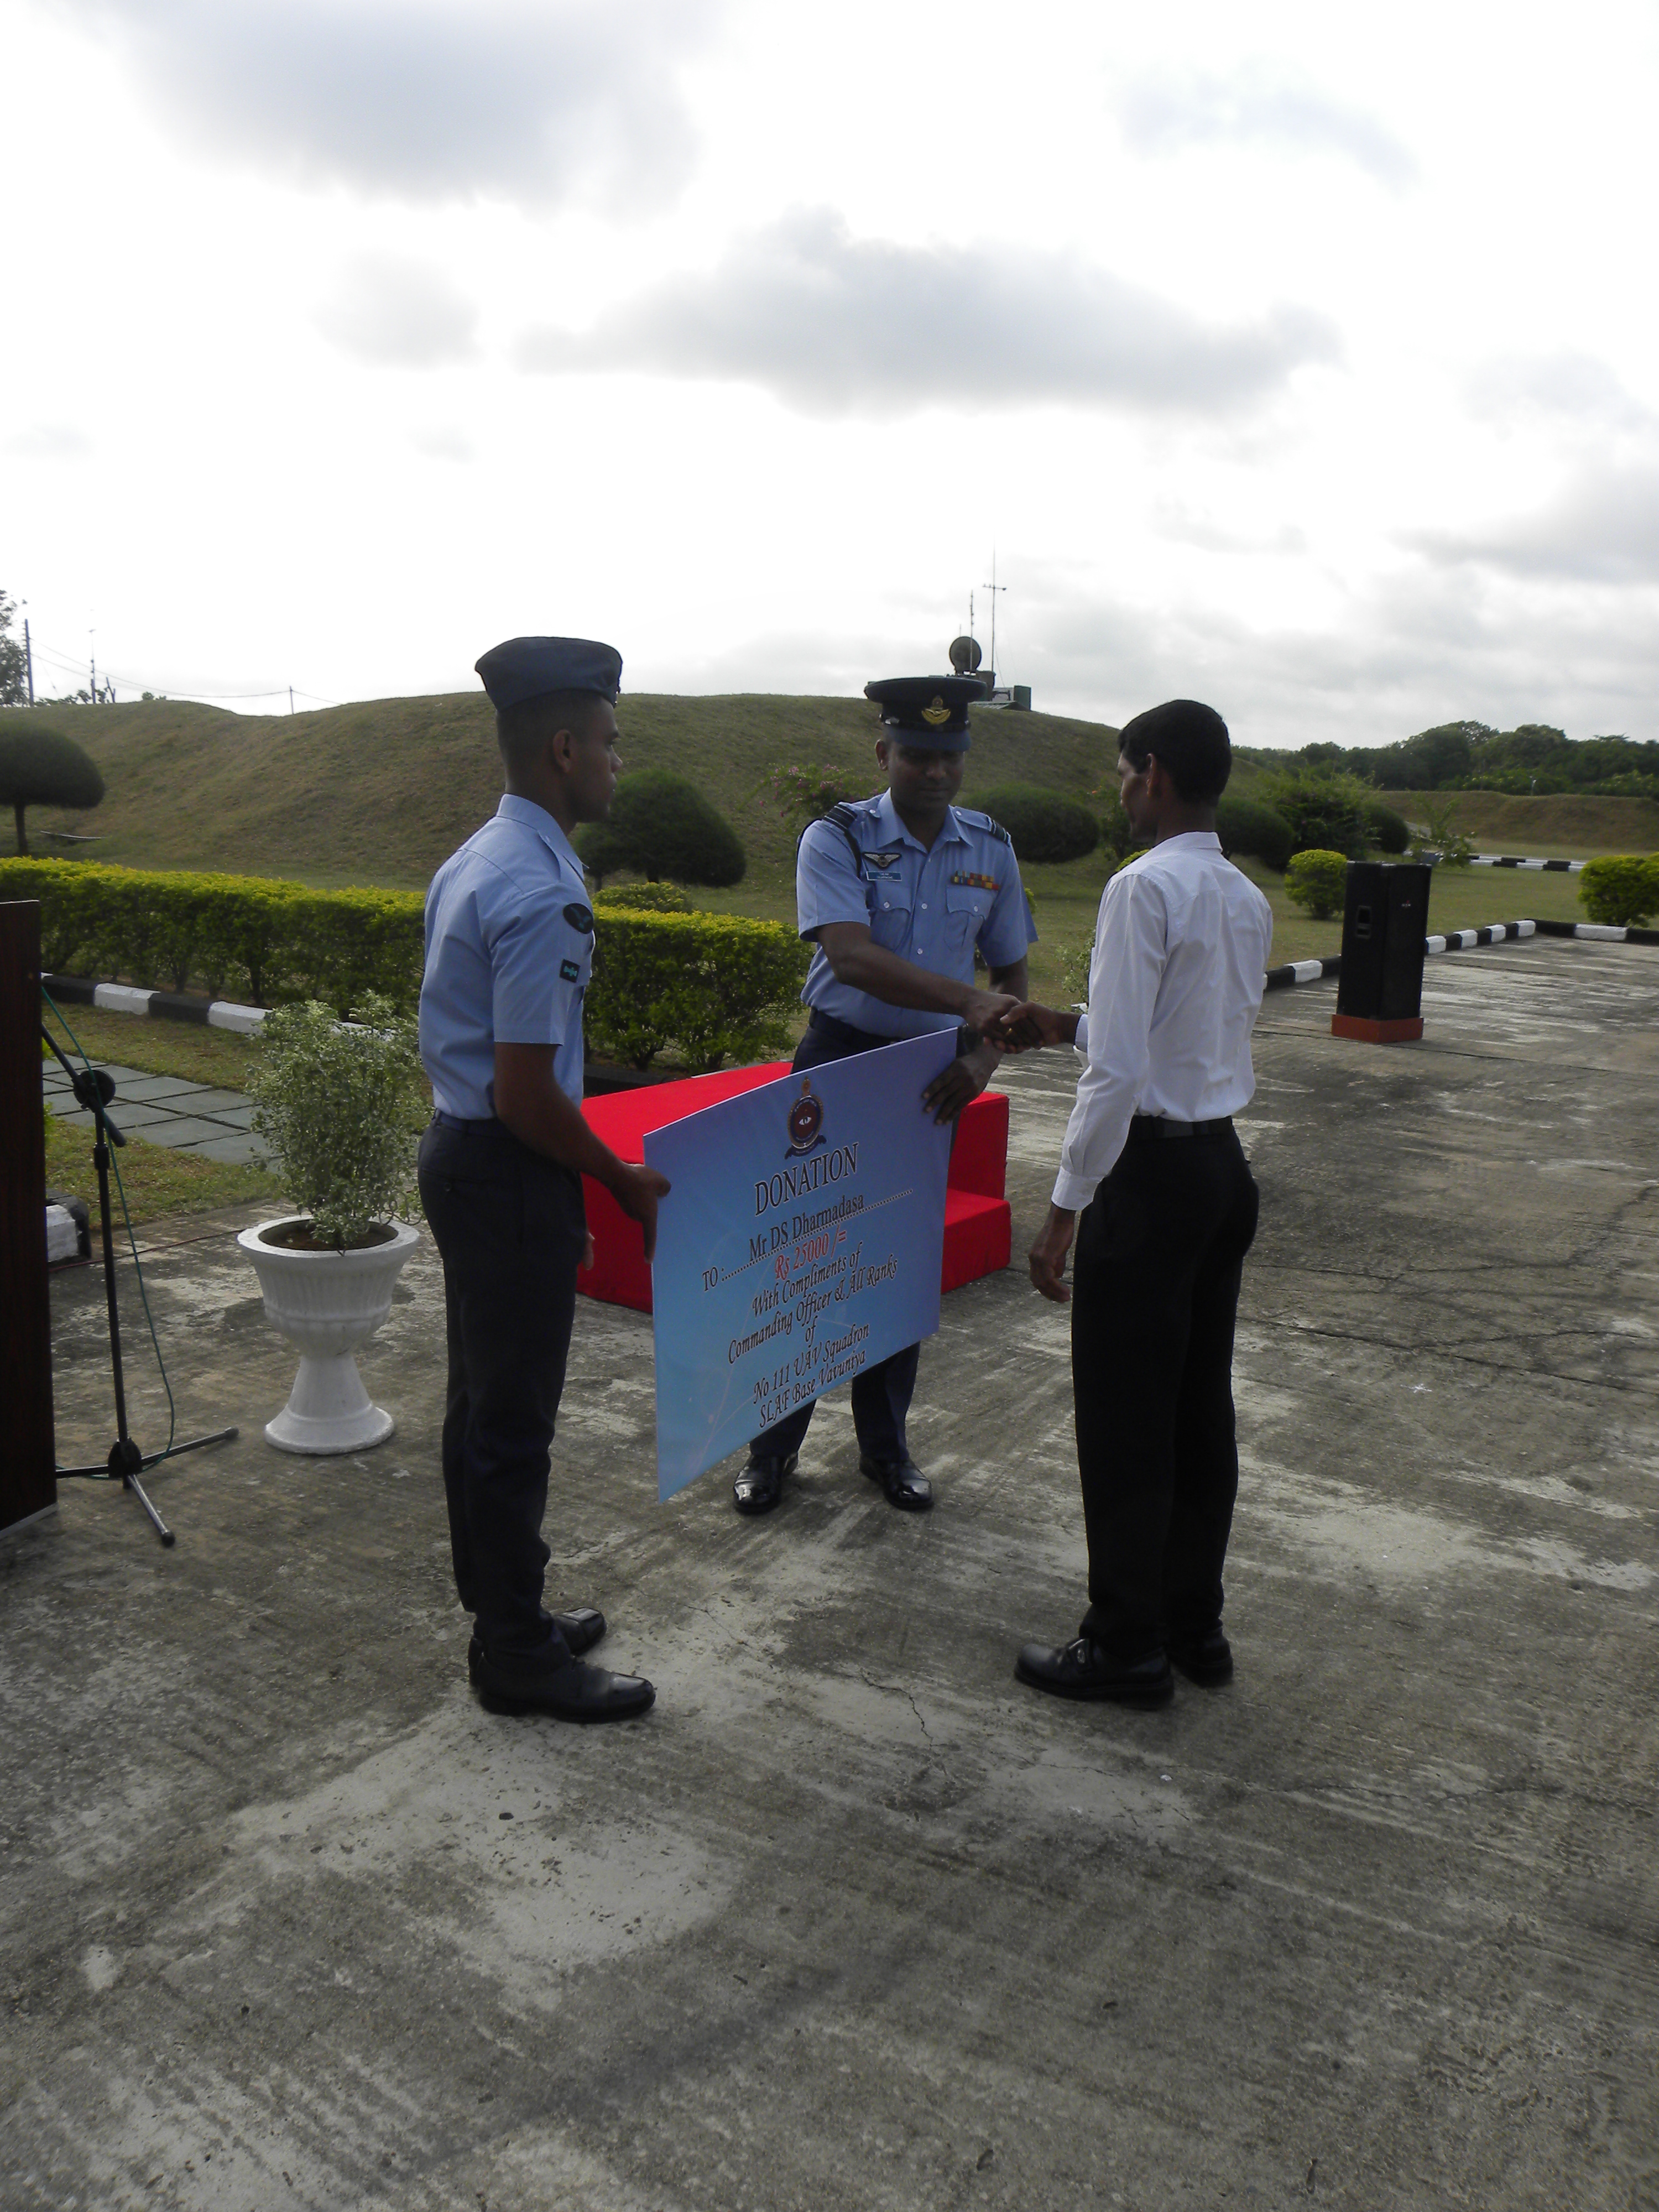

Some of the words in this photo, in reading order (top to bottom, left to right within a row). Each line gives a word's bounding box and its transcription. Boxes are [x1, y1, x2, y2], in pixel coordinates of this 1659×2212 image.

[754, 1142, 858, 1217] DONATION
[749, 1234, 767, 1261] Mr
[770, 1222, 788, 1250] DS
[792, 1194, 864, 1239] Dharmadasa
[775, 1254, 790, 1280] Rs
[793, 1233, 829, 1270] 25000
[728, 1310, 793, 1364] Commanding
[796, 1291, 833, 1327] Officer
[834, 1275, 846, 1302] &
[846, 1266, 866, 1300] All
[866, 1253, 898, 1288] Ranks
[752, 1282, 779, 1317] With
[782, 1255, 847, 1304] Compliments
[849, 1241, 863, 1273] of
[753, 1377, 769, 1404] No
[773, 1363, 790, 1391] 111
[794, 1341, 822, 1376] UAV
[823, 1323, 869, 1364] Squadron
[805, 1314, 818, 1348] of
[759, 1389, 790, 1428] SLAF
[792, 1378, 816, 1404] Base
[818, 1349, 866, 1386] Vavuniya
